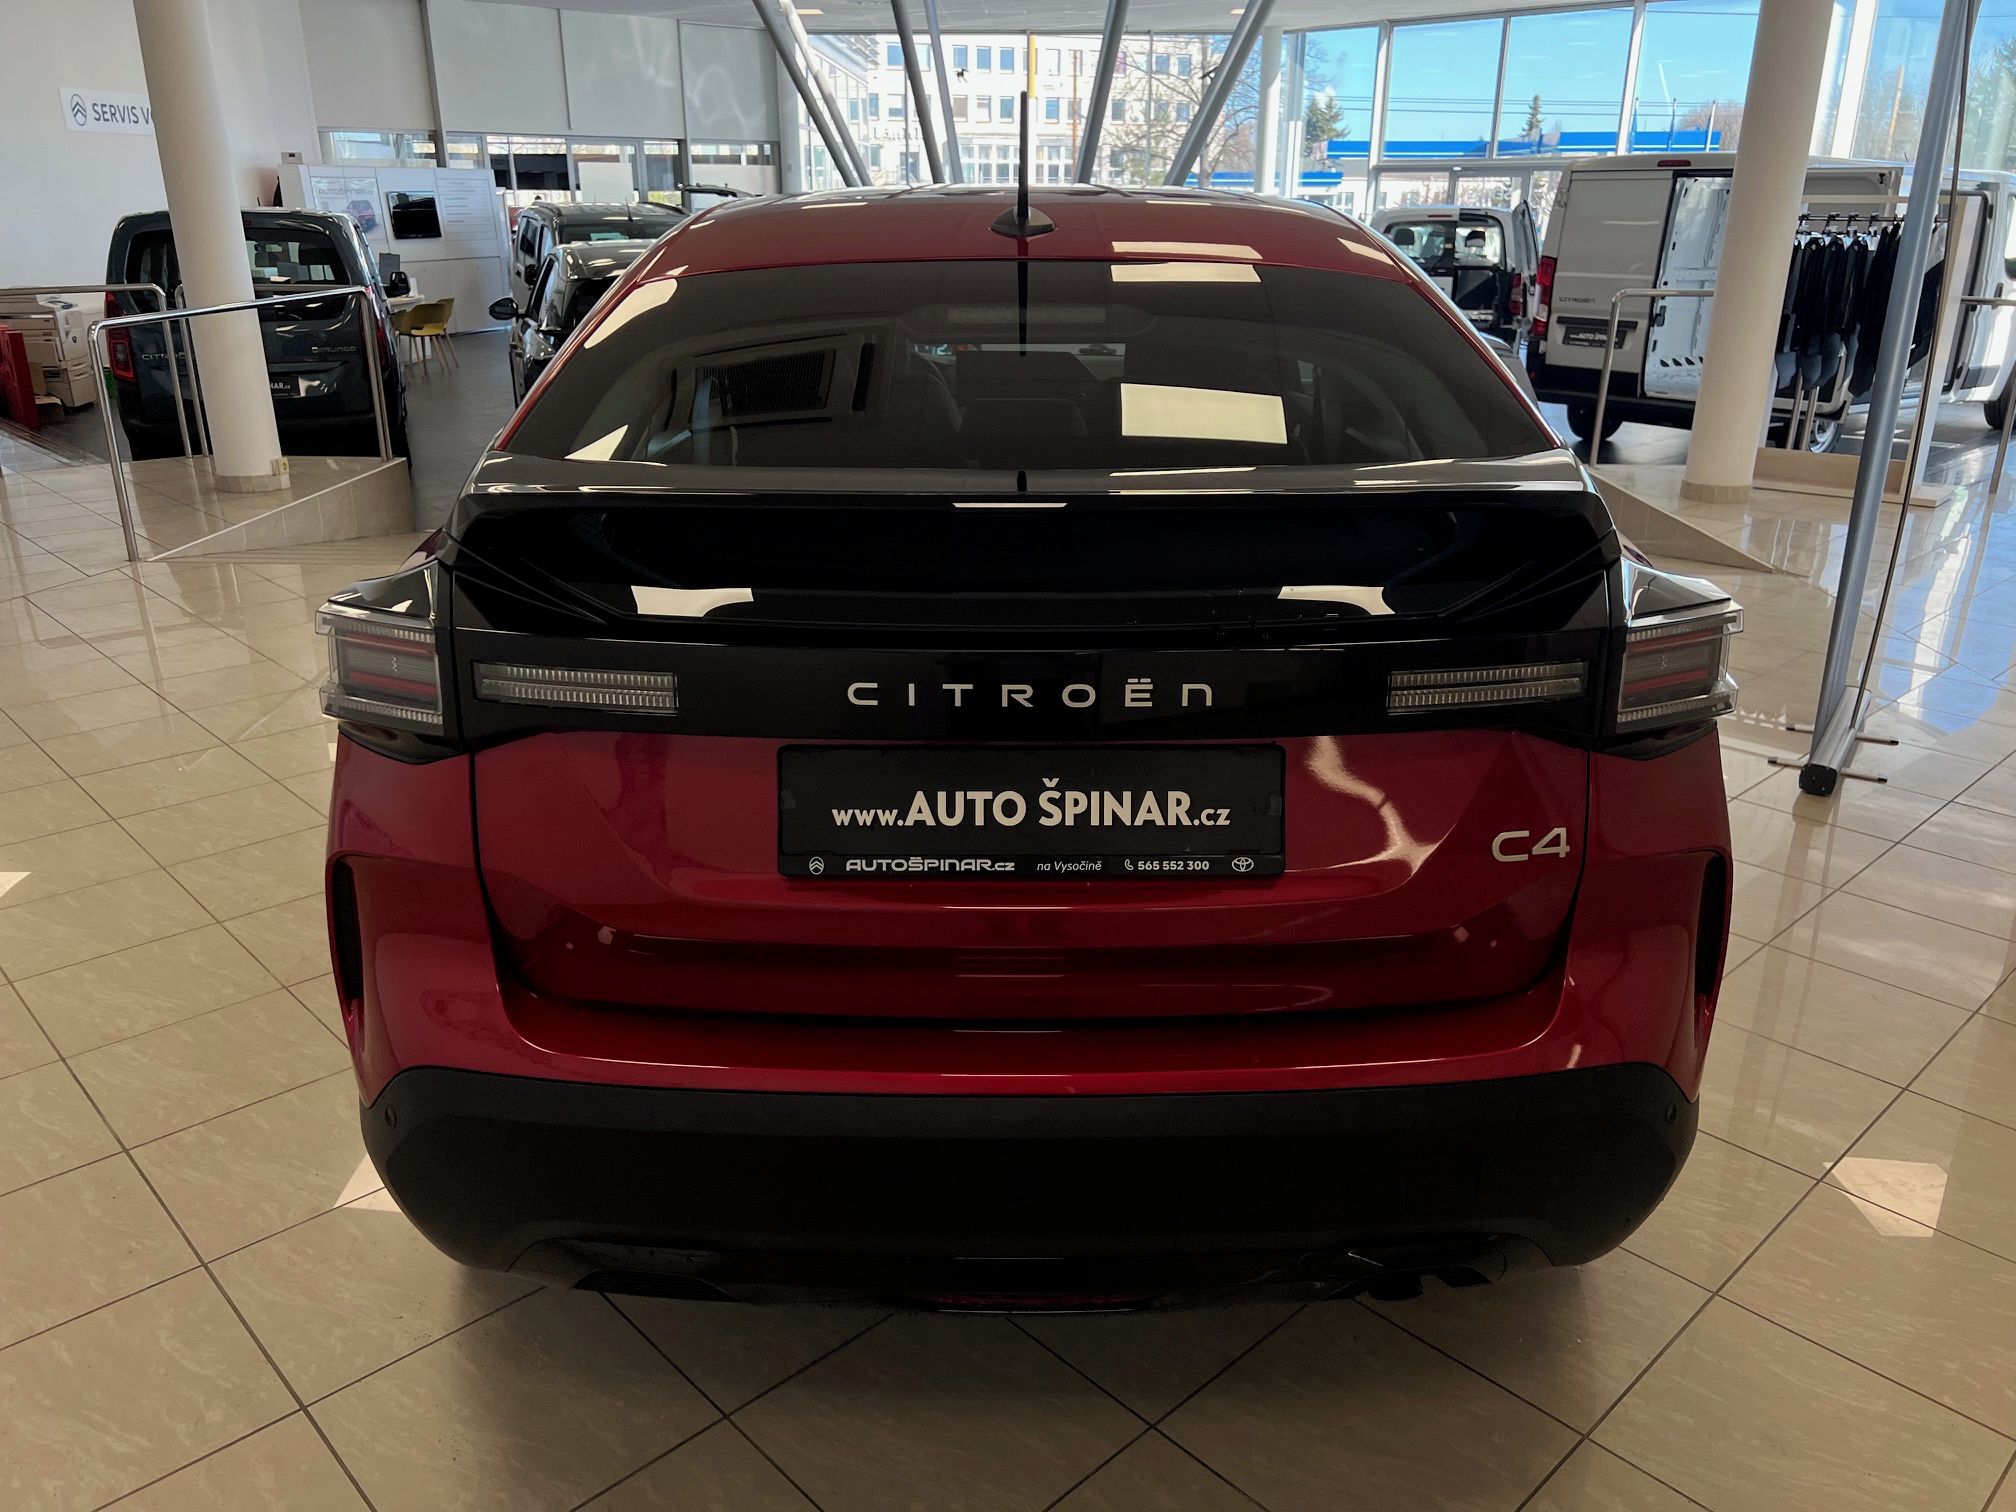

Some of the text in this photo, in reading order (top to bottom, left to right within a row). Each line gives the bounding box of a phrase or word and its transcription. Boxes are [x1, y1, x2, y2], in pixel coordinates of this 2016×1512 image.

[92, 102, 152, 125] SERVIS V
[847, 678, 1213, 708] CITROËN
[831, 777, 1231, 827] www.AUTO ŠPINAR.cz
[1492, 827, 1570, 862] C4
[845, 856, 1210, 873] AUTOŠPINAR.cz na Vysočině 565 552 300
